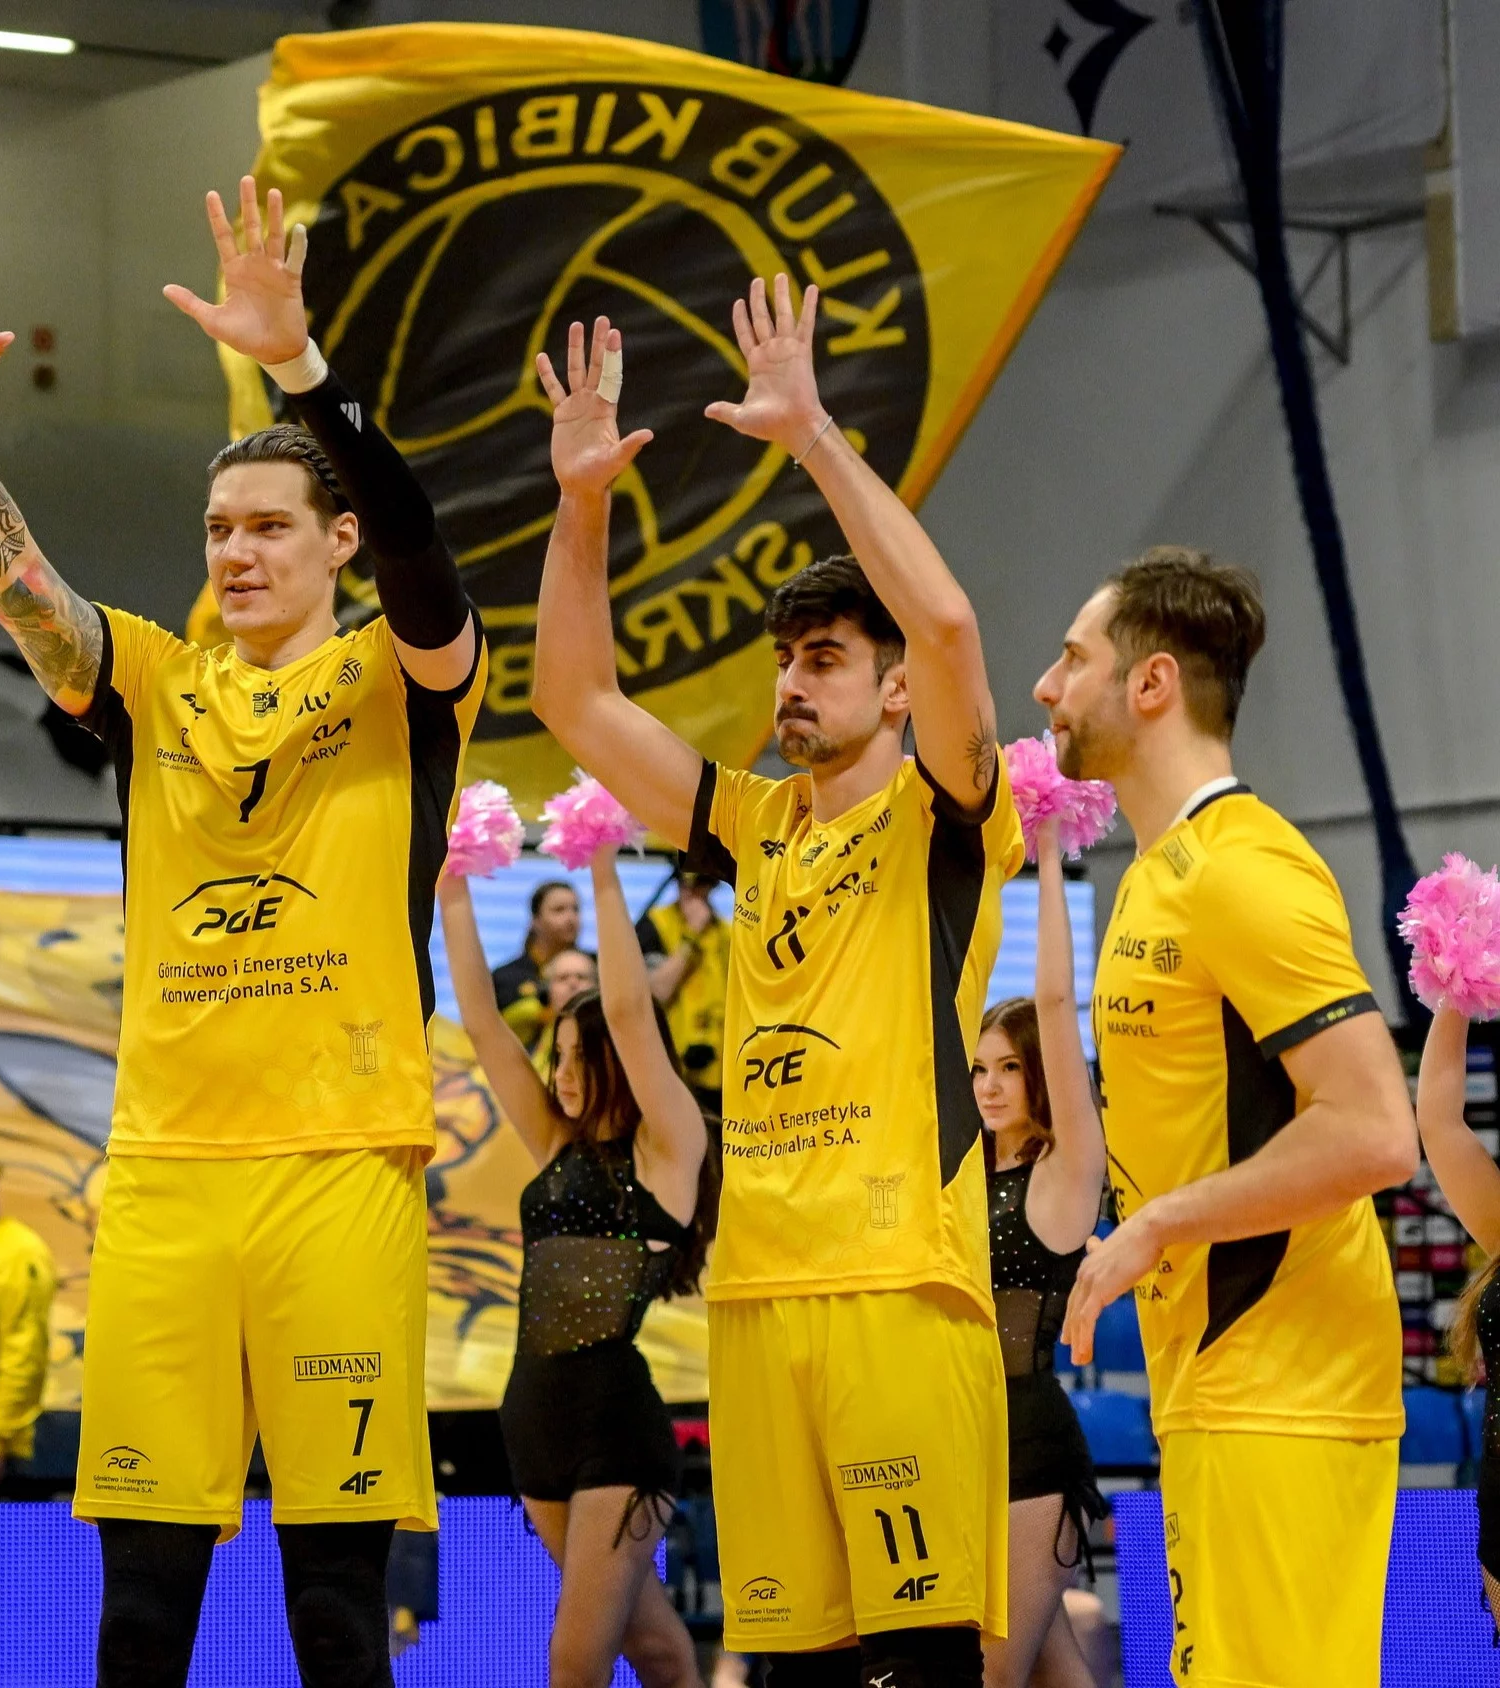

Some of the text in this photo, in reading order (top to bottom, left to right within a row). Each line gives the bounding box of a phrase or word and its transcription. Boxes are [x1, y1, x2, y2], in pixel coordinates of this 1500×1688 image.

[232, 758, 271, 823] 7
[827, 881, 879, 917] MVEL
[191, 896, 283, 937] PGE
[766, 905, 812, 970] 11
[1111, 931, 1147, 961] plus
[158, 950, 348, 980] Górnictwo i Energetyka
[161, 975, 339, 1004] Konwencjonalna S.A.
[1108, 995, 1154, 1014] KIA
[769, 1115, 775, 1132] i
[780, 1101, 871, 1130] Energetyka
[723, 1128, 861, 1160] nwencjonalna S.A.
[297, 1357, 377, 1377] LIEDMANN
[348, 1399, 374, 1456] 7
[107, 1457, 140, 1470] PGE
[339, 1470, 383, 1495] 4F
[874, 1504, 929, 1565] 11
[748, 1588, 777, 1601] PGE
[892, 1573, 940, 1602] 4F
